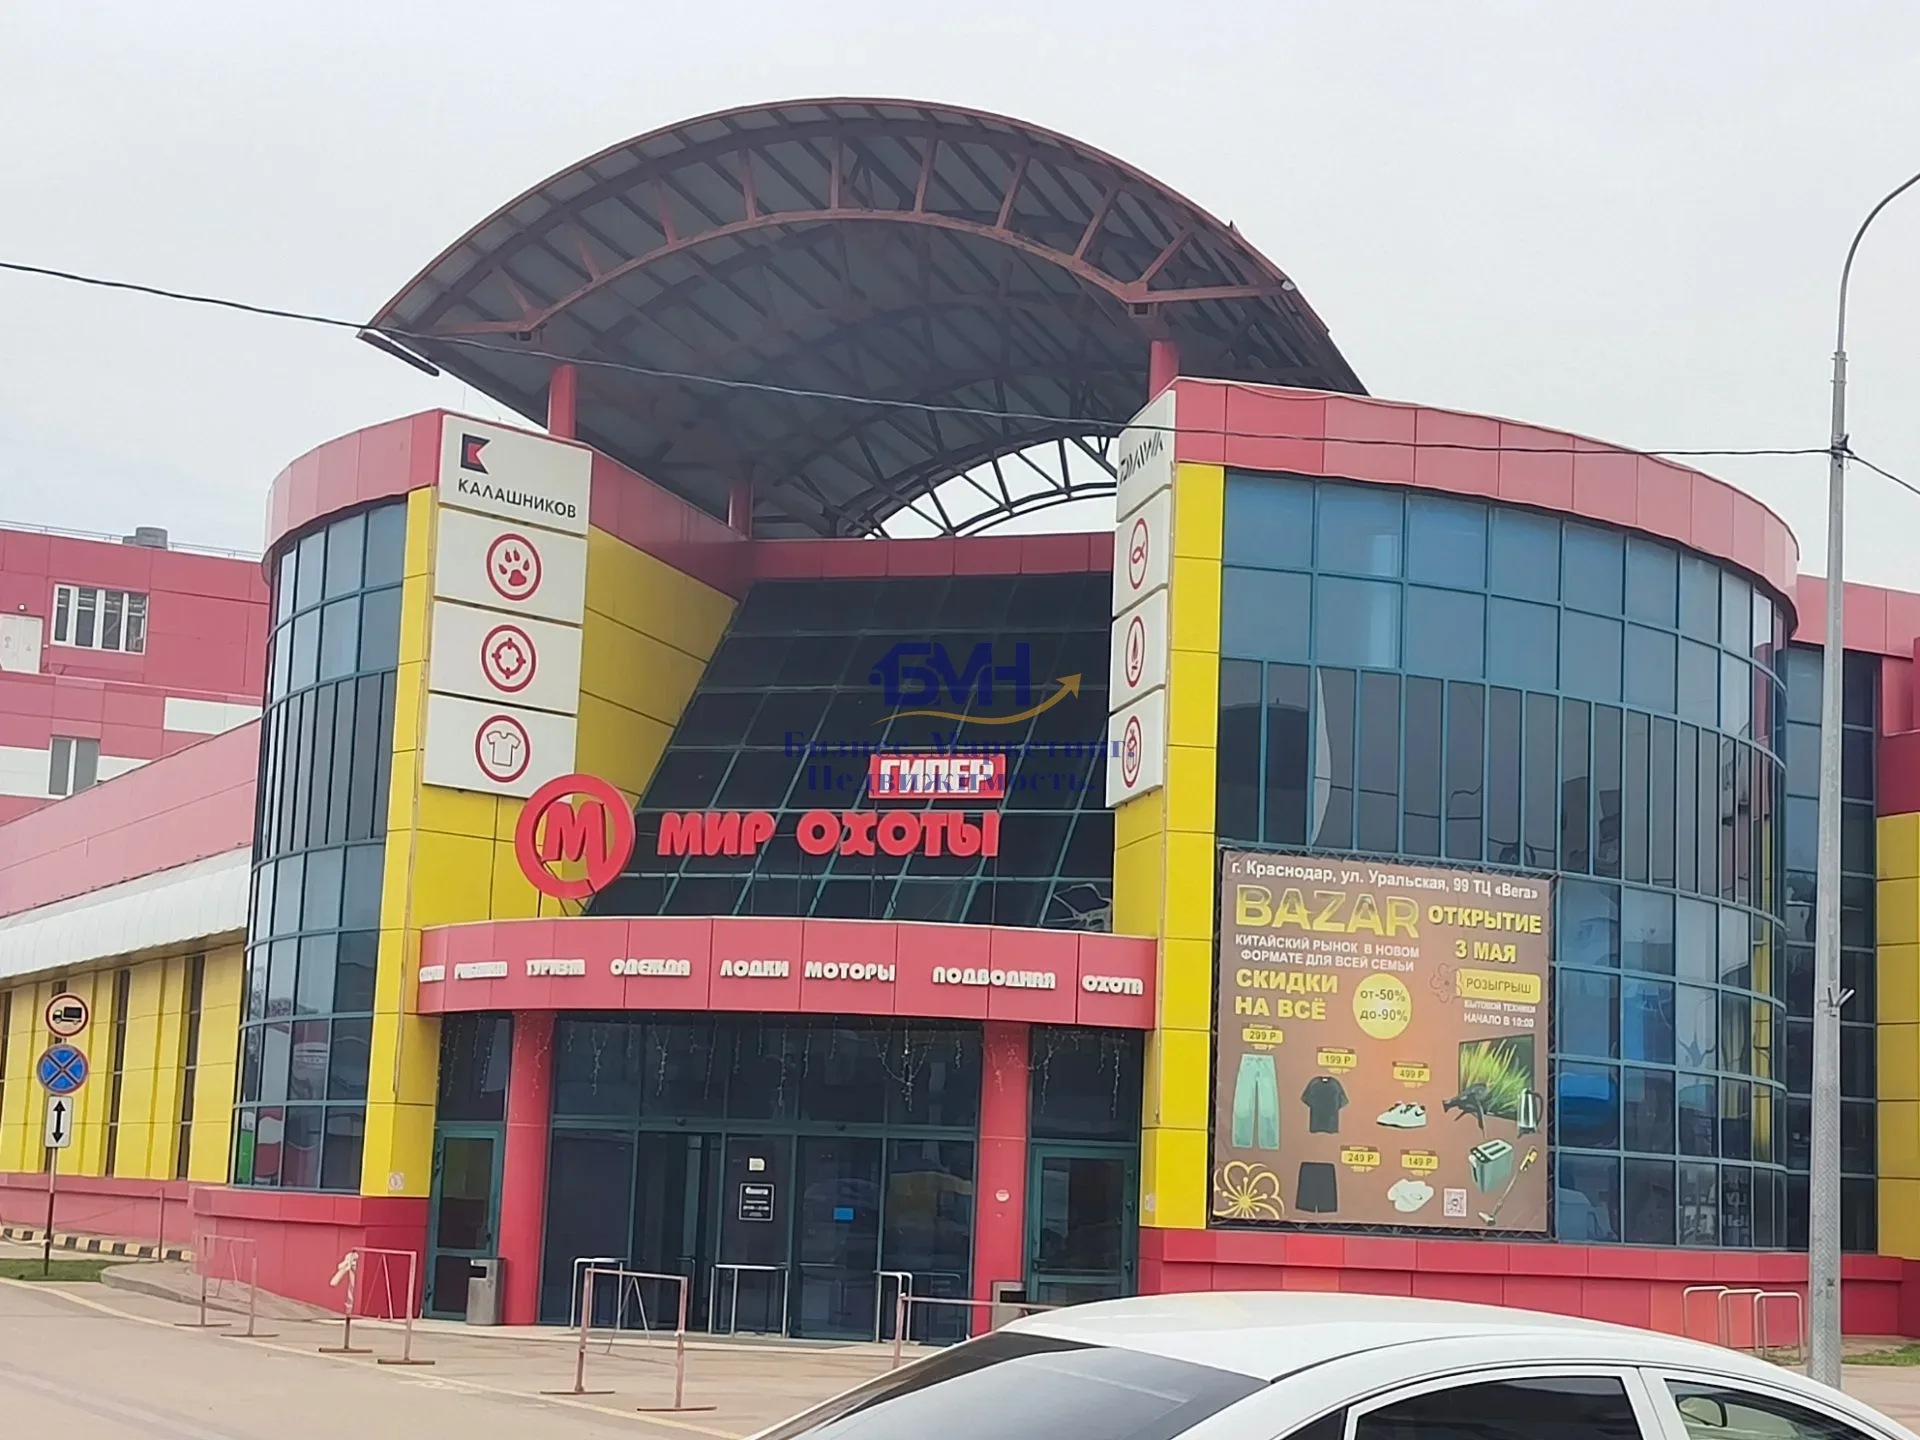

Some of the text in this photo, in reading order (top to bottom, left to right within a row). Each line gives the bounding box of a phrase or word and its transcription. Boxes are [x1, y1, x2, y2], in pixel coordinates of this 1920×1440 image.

[458, 478, 577, 519] КАЛАШНИКОВ
[879, 759, 994, 794] ГИПЕР
[657, 811, 1000, 859] МИР ОХОТЫ
[1231, 860, 1538, 899] г. Краснодар, ул. Уральская, 99 ТЦ «Вега»
[1235, 884, 1420, 939] BAZAR
[1428, 904, 1542, 935] ОТКРЫТИЕ
[1235, 934, 1420, 958] КИТАЙСКИЙ РЫНОК В НОВОМ
[1455, 939, 1517, 964] 3 МАЯ
[720, 959, 790, 978] ЛОДКИ
[804, 960, 896, 982] МОТОРЫ
[1240, 949, 1414, 972] ФОРМАТЕ ДЛЯ ВСЕЙ СЕМЬИ
[932, 966, 1144, 995] ПОДВОДНАЯ ОХОТА
[1236, 968, 1338, 995] СКИДКИ
[1466, 977, 1532, 994] РОЗЫГРЫШ
[1235, 996, 1327, 1020] НА ВСЁ
[1464, 1012, 1535, 1028] НАЧАЛО В 10:00
[1249, 1030, 1267, 1040] 299
[1325, 1055, 1341, 1065] 199
[1399, 1068, 1416, 1079] 499
[1347, 1152, 1365, 1163] 249
[1408, 1156, 1424, 1166] 149
